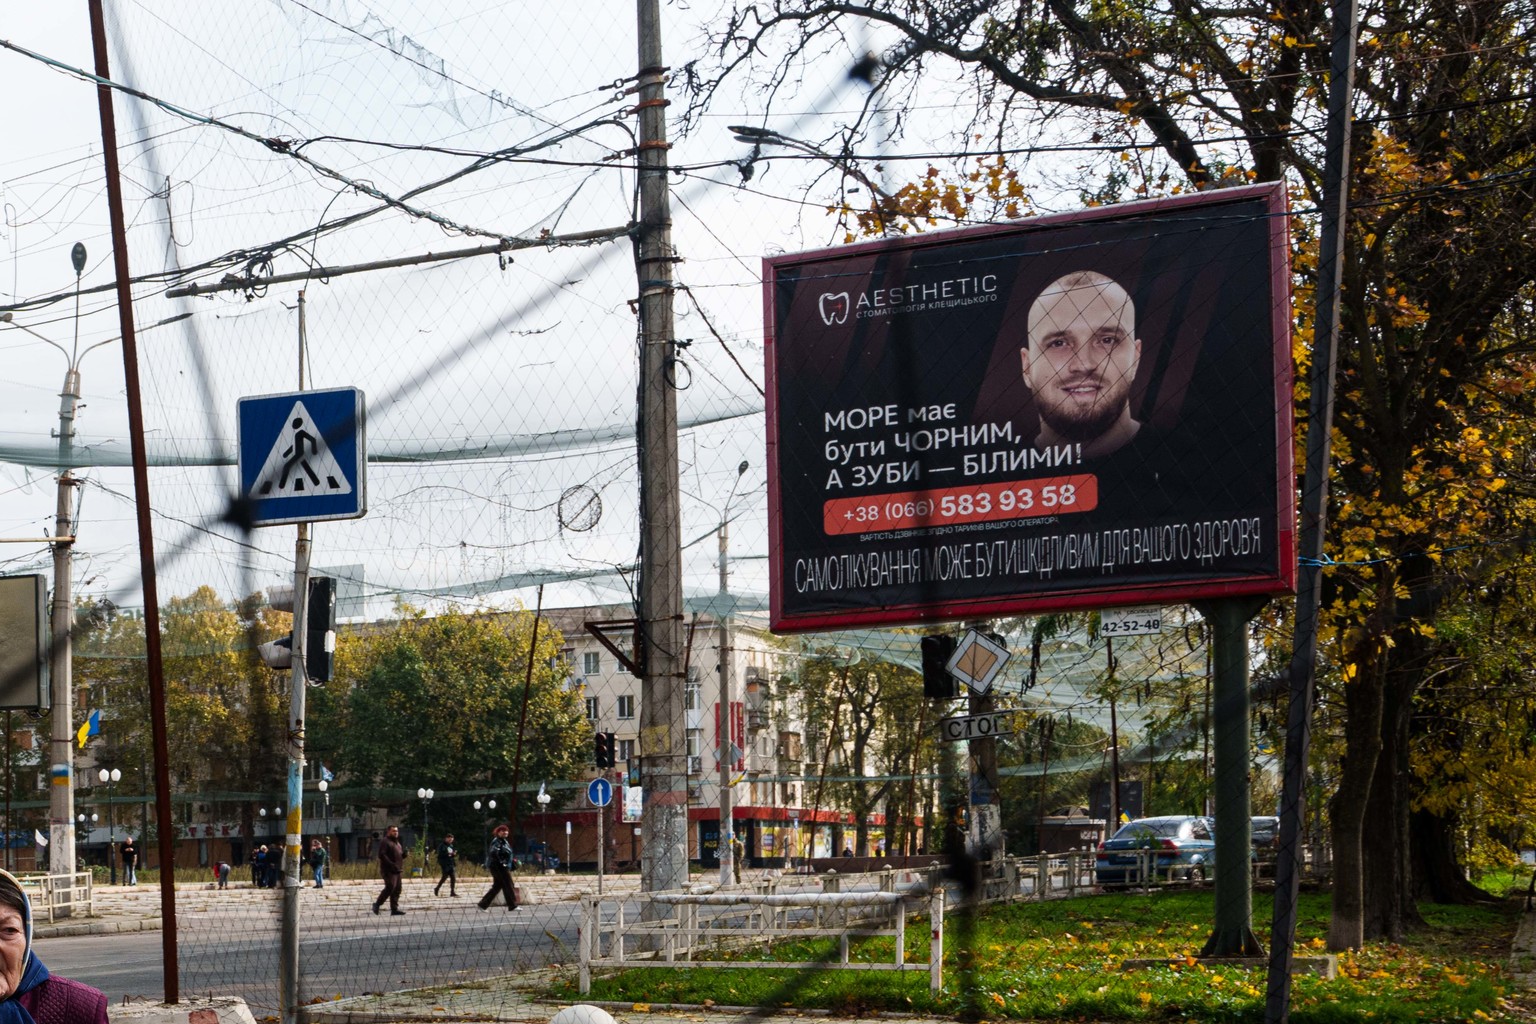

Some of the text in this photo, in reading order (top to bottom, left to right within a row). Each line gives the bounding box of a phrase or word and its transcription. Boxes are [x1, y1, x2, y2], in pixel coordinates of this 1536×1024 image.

[855, 274, 998, 309] AESTHETIC
[855, 293, 998, 319] СТОМАТОЛОГІЯ КЛЕЩИЦЬКОГО
[824, 403, 957, 433] МОРЕ має
[824, 420, 1023, 465] бути ЧОРНИМ,
[824, 468, 844, 490] А
[851, 460, 921, 487] ЗУБИ
[963, 443, 1083, 476] БІЛИМИ!
[843, 483, 1077, 523] +38 (066) 583 93 58
[985, 520, 1016, 530] ВАШОГО
[794, 547, 921, 593] САМОЛІКУВАННЯ
[924, 542, 972, 582] МОЖЕ
[975, 540, 1017, 578] БУТИ
[1102, 529, 1131, 574] ДЛЯ
[1133, 523, 1191, 563] ВАШОГО
